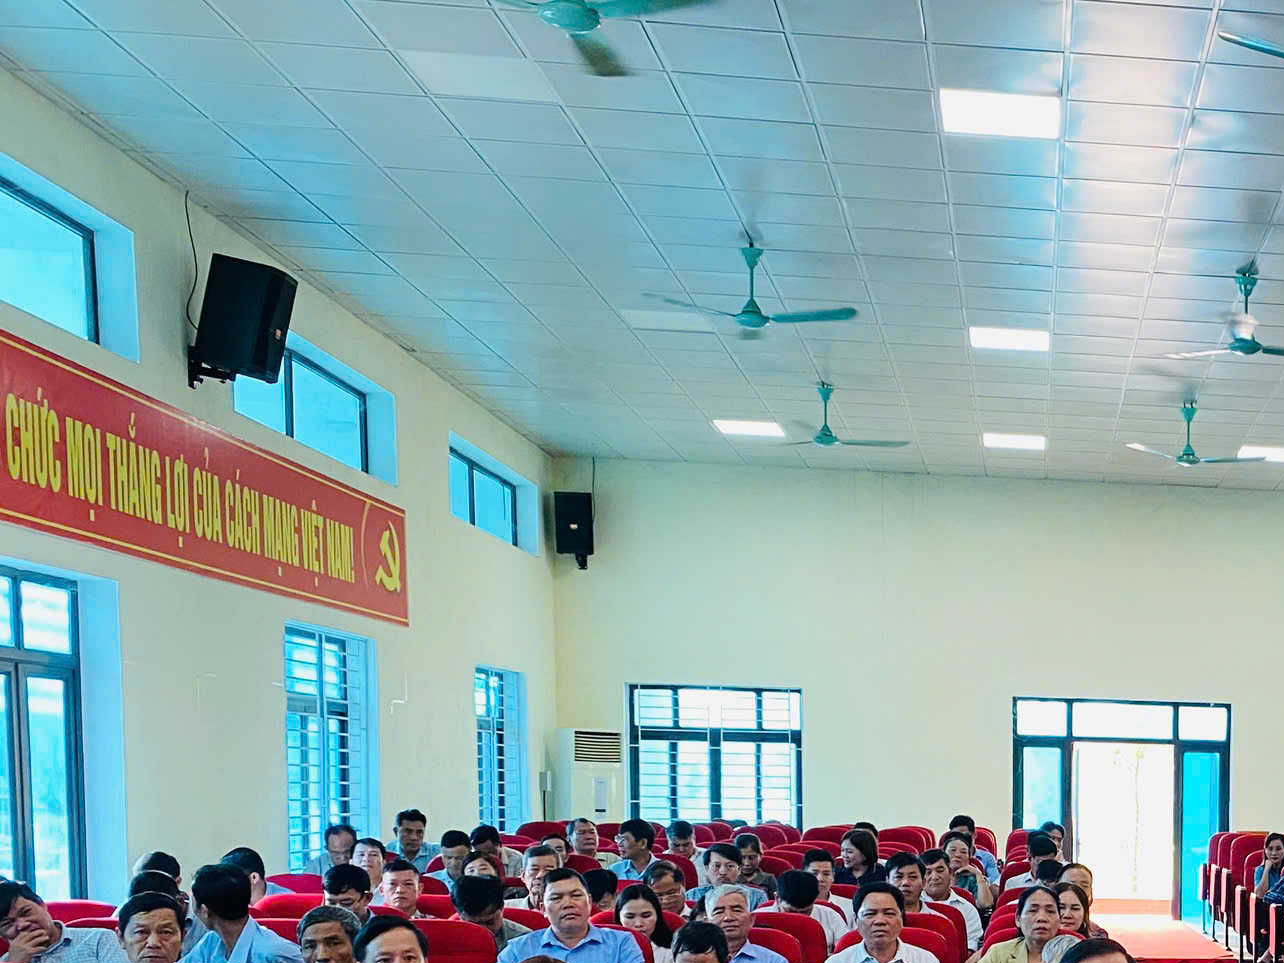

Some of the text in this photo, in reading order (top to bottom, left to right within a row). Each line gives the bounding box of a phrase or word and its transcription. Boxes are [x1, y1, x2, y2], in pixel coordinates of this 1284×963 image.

[6, 387, 61, 493] CHỨC
[66, 417, 103, 522] MỌI
[106, 412, 162, 525] THẮNG
[165, 454, 190, 548] LỢI
[193, 447, 223, 543] CỦA
[225, 469, 261, 555] CÁCH
[263, 484, 299, 577] MẠNG
[301, 500, 324, 587] VIỆT
